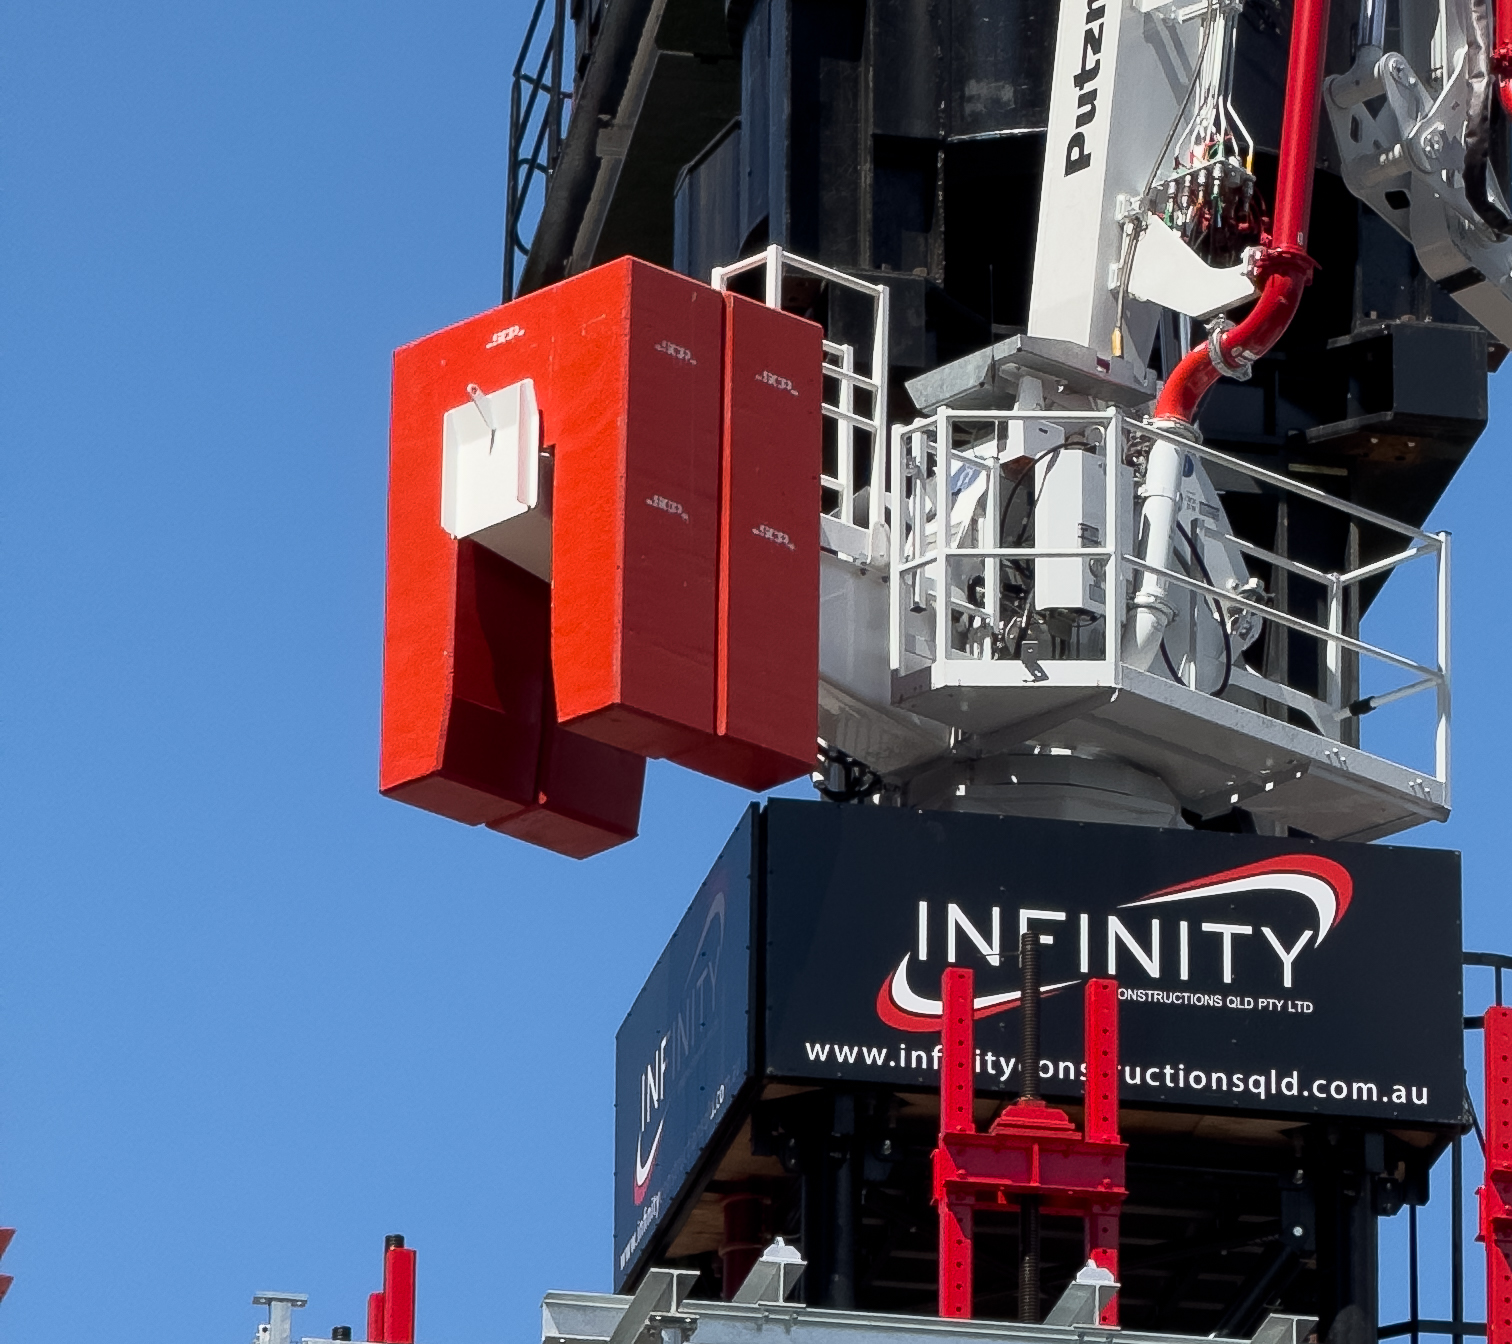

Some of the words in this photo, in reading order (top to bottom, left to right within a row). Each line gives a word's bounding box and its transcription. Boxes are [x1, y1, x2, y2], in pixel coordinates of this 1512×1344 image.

[918, 901, 1314, 988] INFINITY
[1226, 995, 1254, 1010] QLD
[1258, 998, 1284, 1012] PTY
[1287, 999, 1314, 1014] LTD
